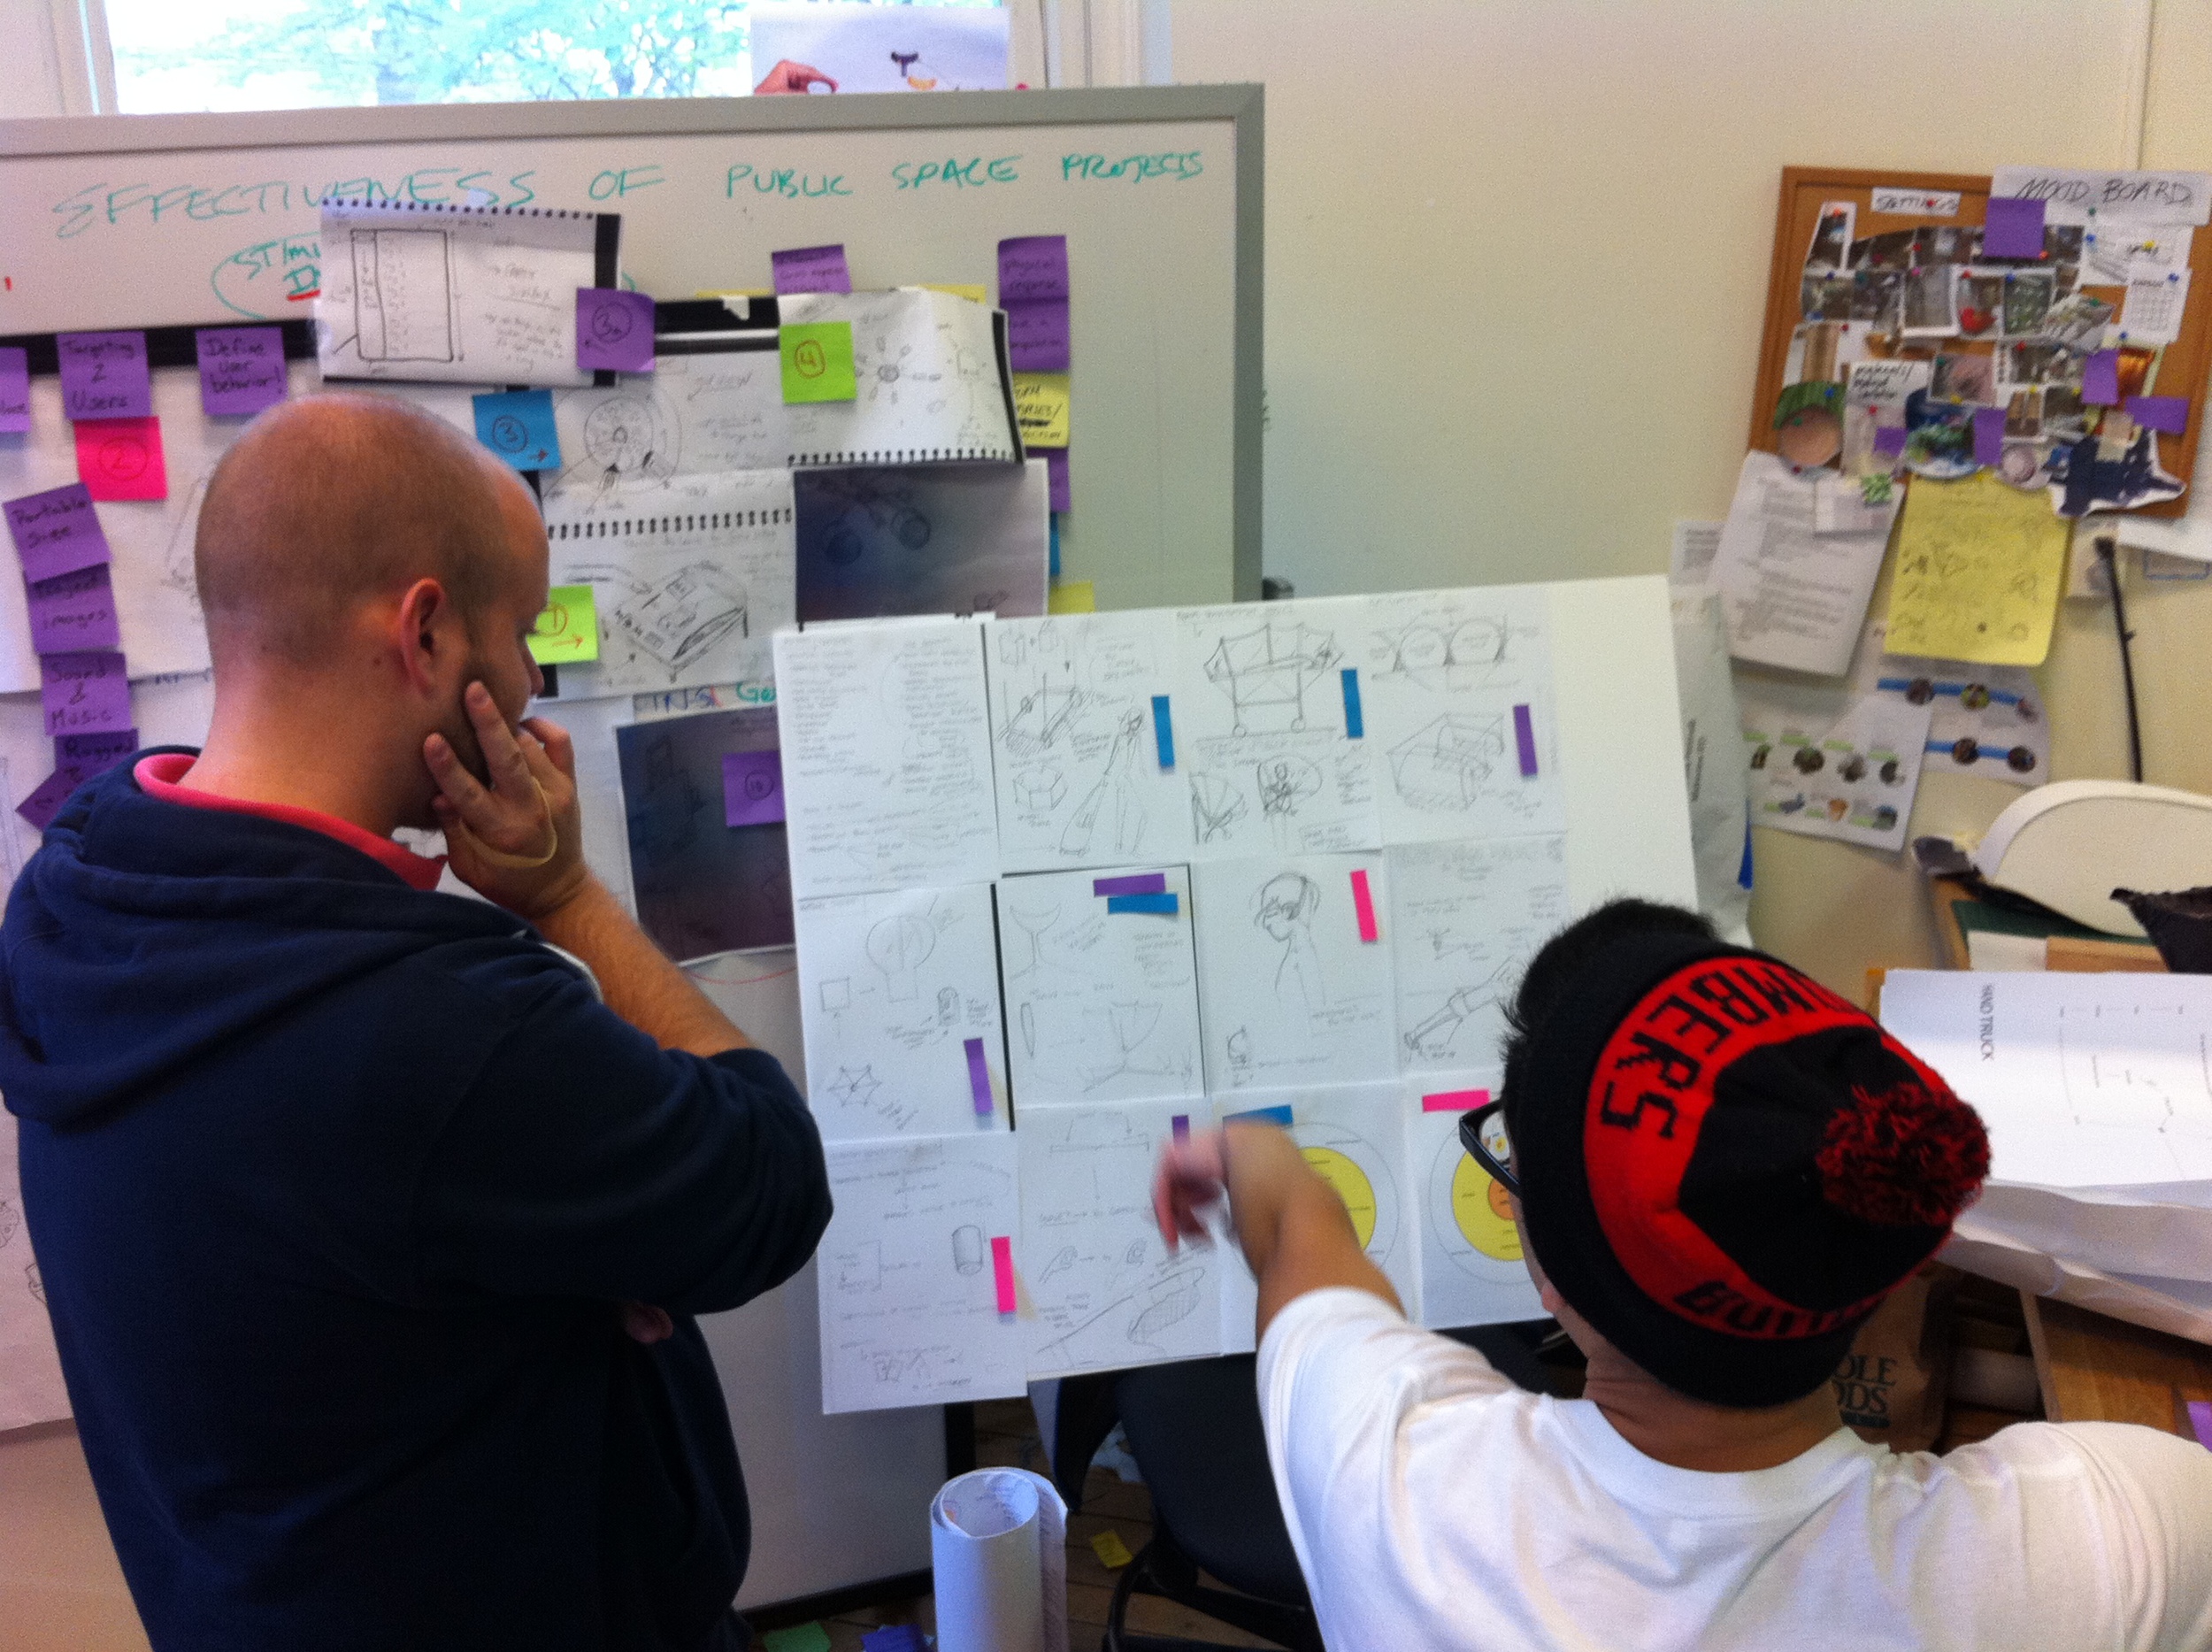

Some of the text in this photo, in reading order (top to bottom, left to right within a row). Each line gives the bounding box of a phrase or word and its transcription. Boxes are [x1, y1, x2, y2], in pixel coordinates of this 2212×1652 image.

[52, 167, 536, 239] EFFECTIVENESS
[589, 165, 665, 201] OF
[726, 164, 854, 198] PUBLIC
[891, 155, 1023, 190] SPACE
[2016, 177, 2194, 207] MOOD BOARD
[90, 363, 107, 384] 2
[72, 390, 128, 412] Users
[50, 707, 113, 730] Music
[1979, 1016, 1994, 1061] TRUCK
